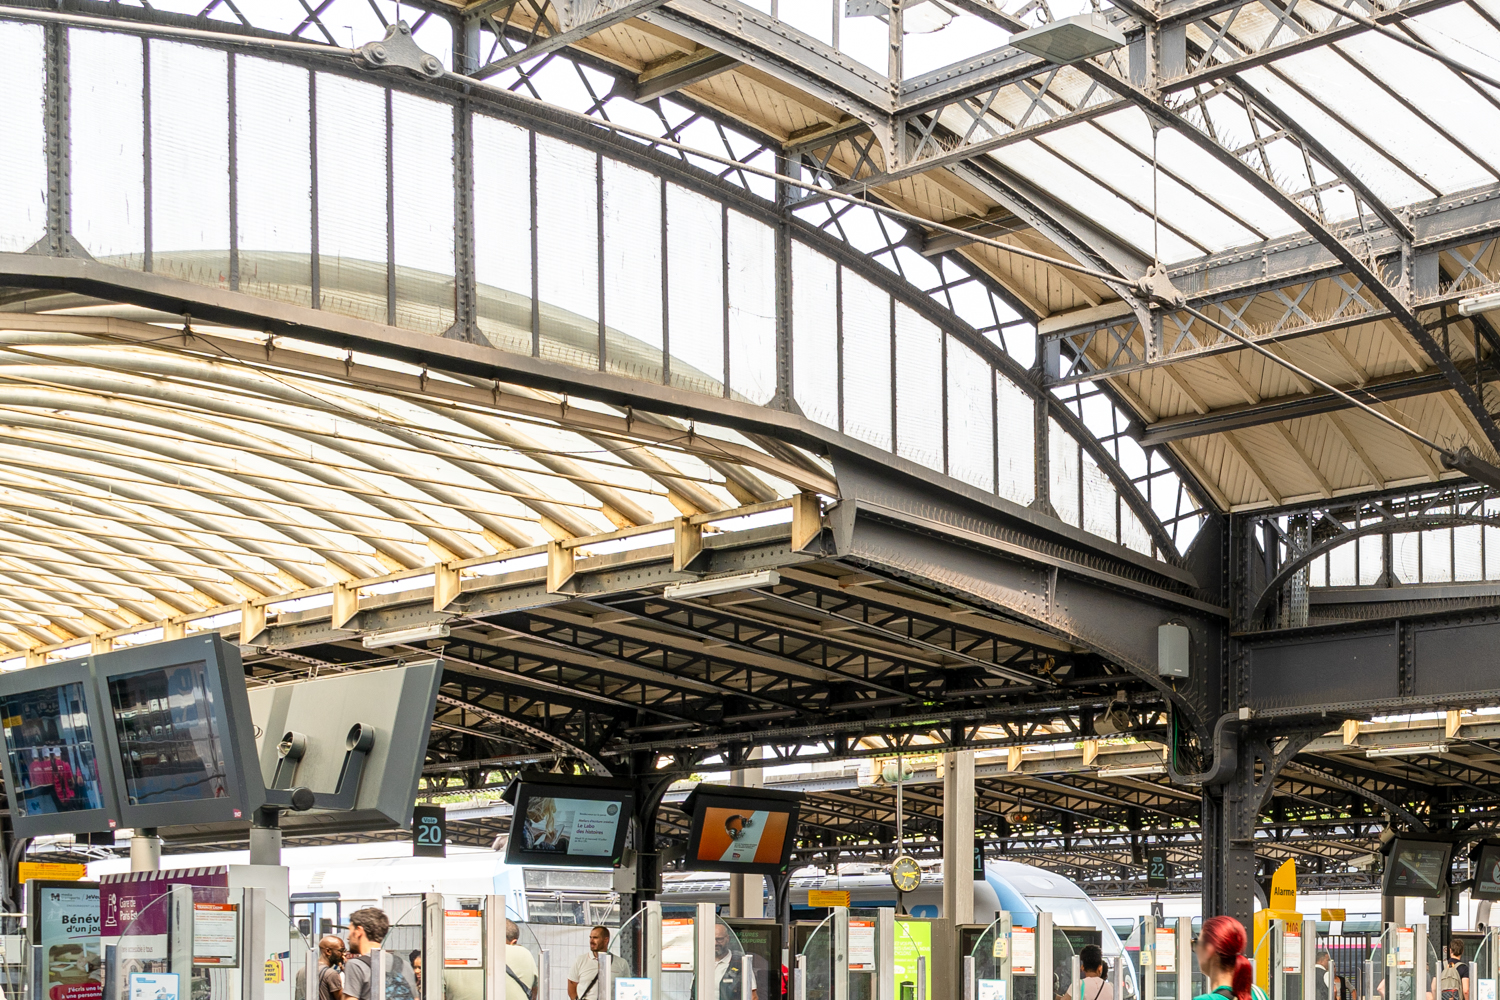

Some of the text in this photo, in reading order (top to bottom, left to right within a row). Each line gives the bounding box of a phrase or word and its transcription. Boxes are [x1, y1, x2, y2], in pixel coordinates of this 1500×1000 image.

[418, 825, 442, 843] 20
[1151, 863, 1164, 876] 22
[1274, 887, 1294, 896] Alarme
[120, 898, 130, 908] Gare
[120, 910, 130, 920] Paris
[1154, 907, 1161, 918] A
[62, 914, 99, 924] Bénév
